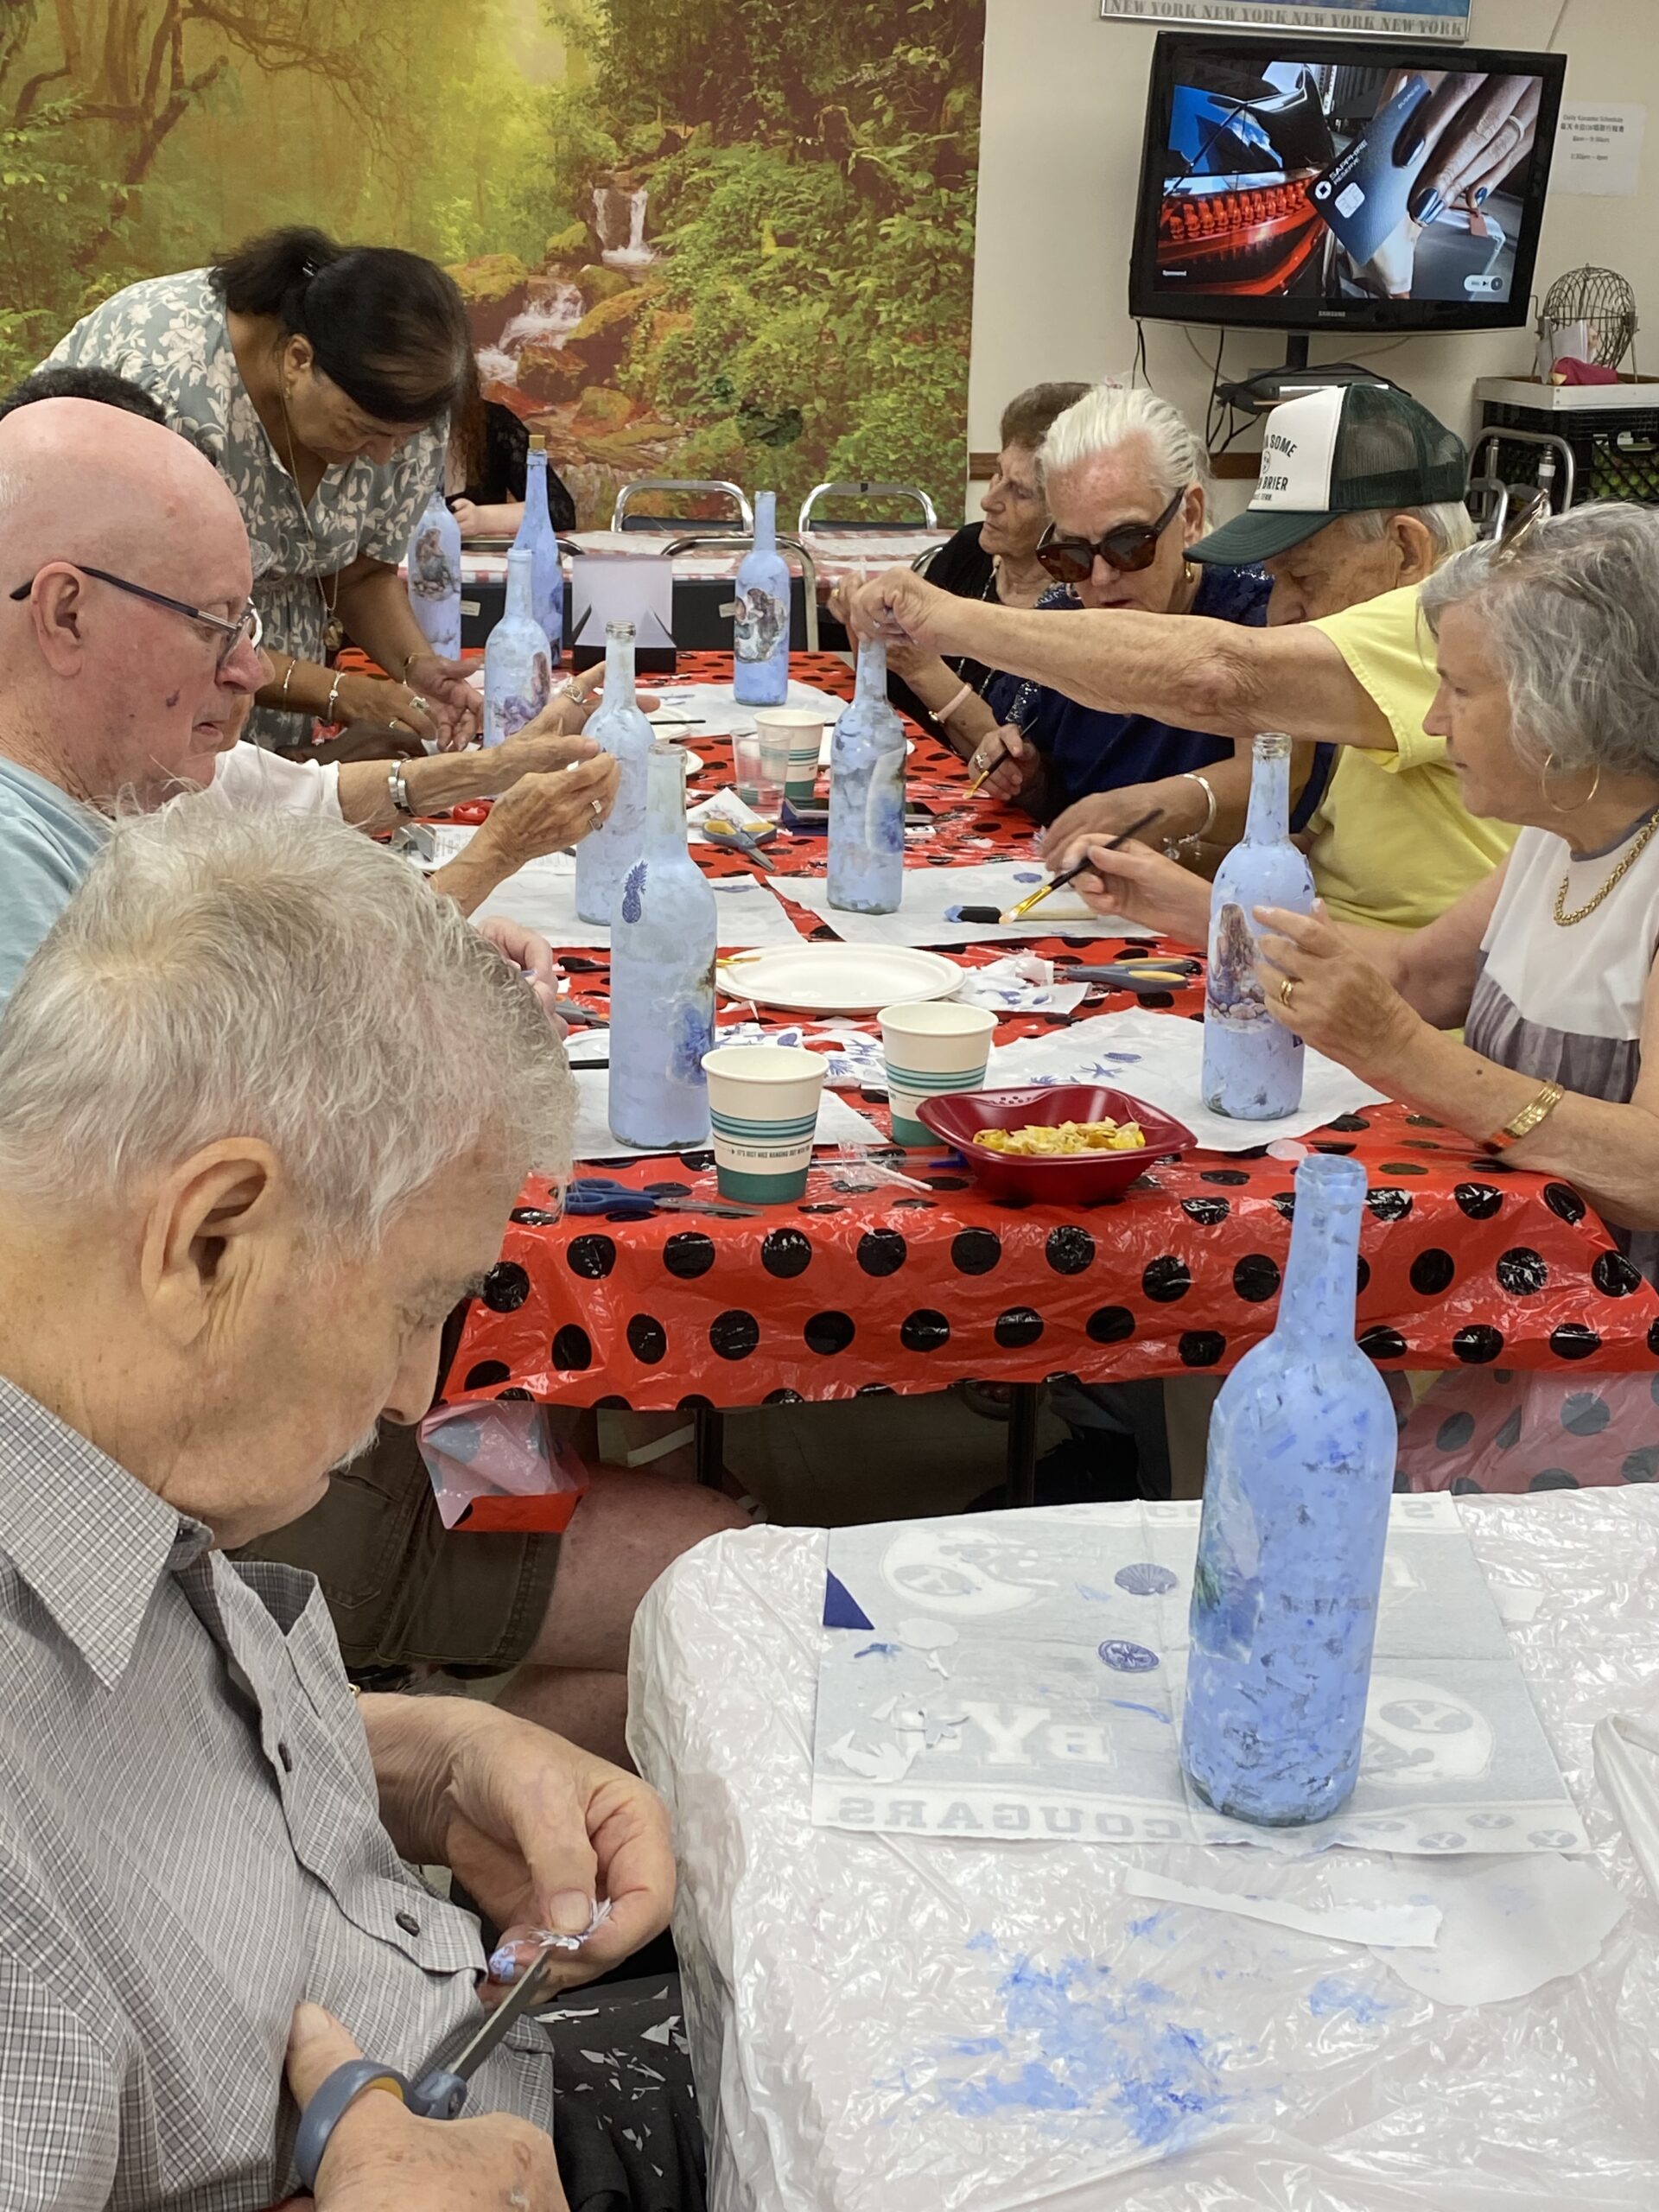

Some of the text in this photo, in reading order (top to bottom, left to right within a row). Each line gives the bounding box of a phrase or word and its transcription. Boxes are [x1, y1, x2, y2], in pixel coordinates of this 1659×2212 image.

[1111, 0, 1464, 36] NEW YORK NEW YORK NEW YORK NEW YORK
[1329, 138, 1369, 179] SAPPHIRE
[1332, 156, 1362, 186] RESERVE
[1269, 434, 1298, 458] SOME
[1262, 475, 1289, 492] BRIER
